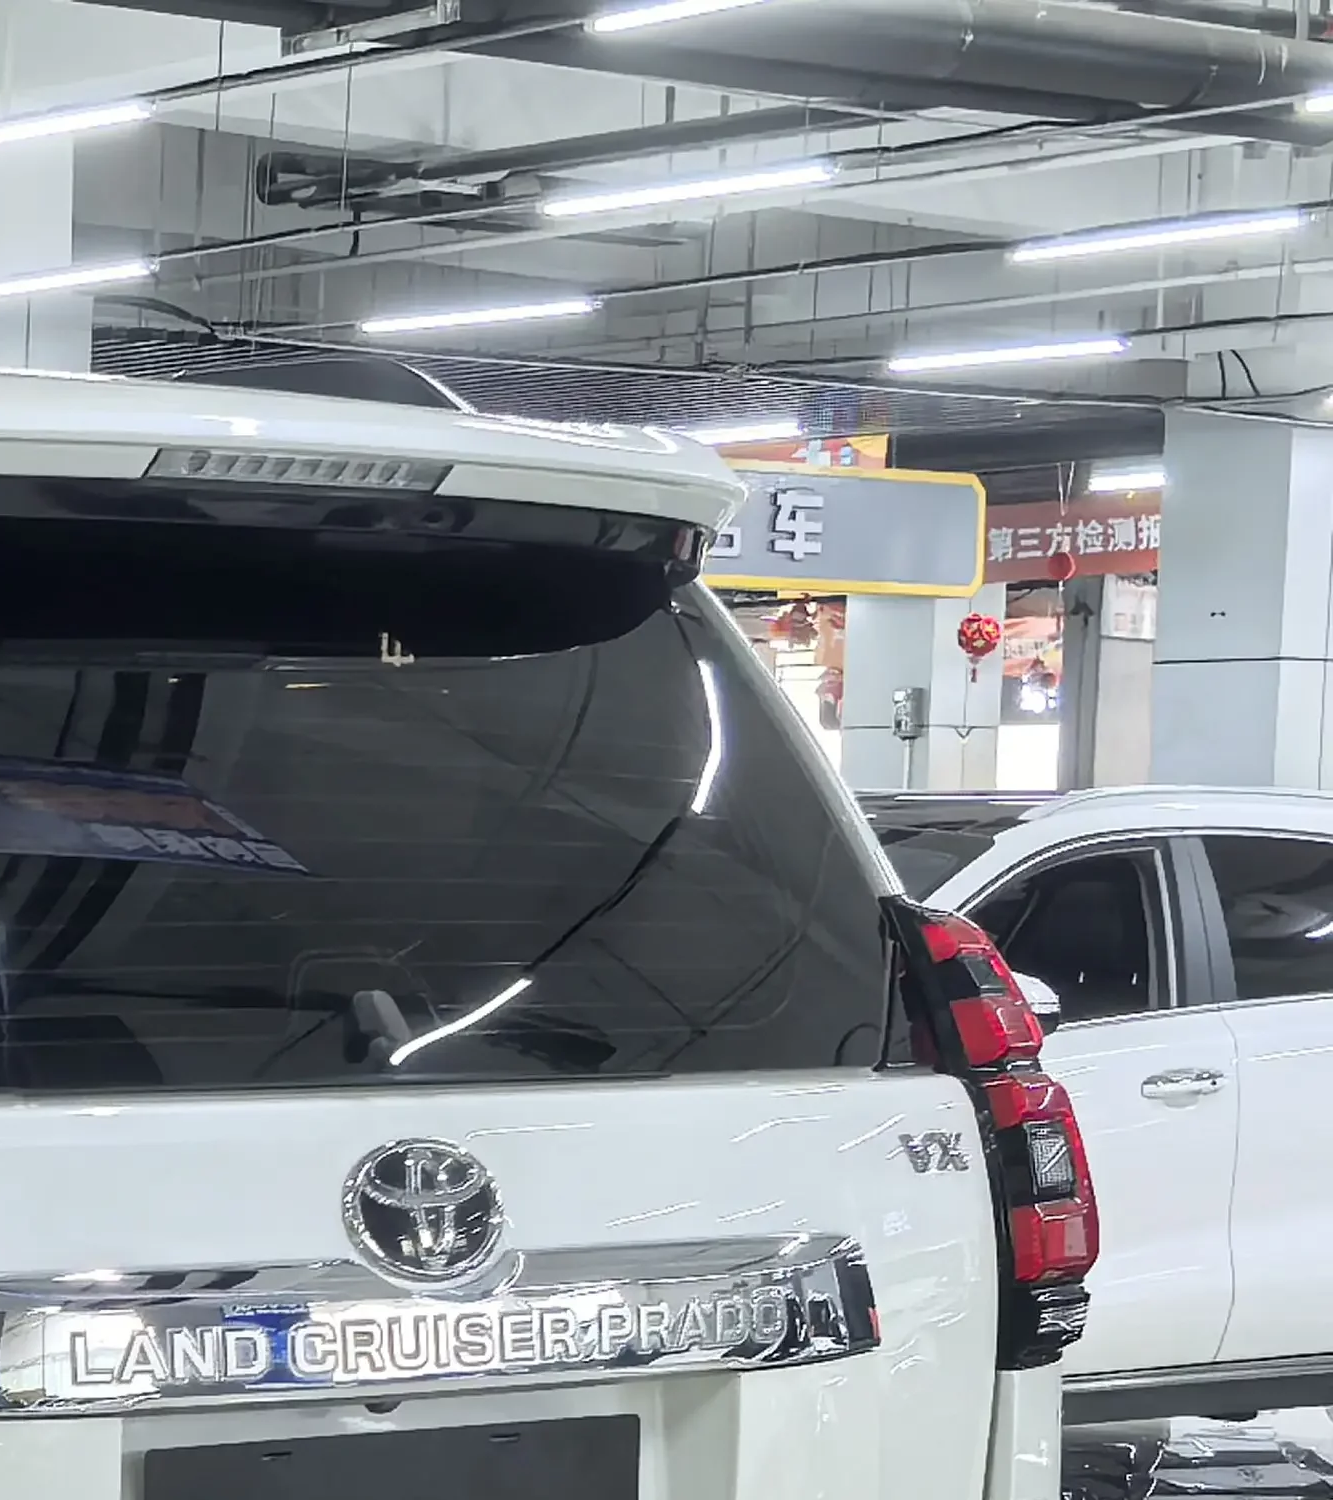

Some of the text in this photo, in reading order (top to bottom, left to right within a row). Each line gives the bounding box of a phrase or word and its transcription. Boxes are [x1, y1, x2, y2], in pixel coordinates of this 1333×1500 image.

[897, 1129, 971, 1173] VX
[69, 1282, 793, 1386] LAND CRUISER PRADO
